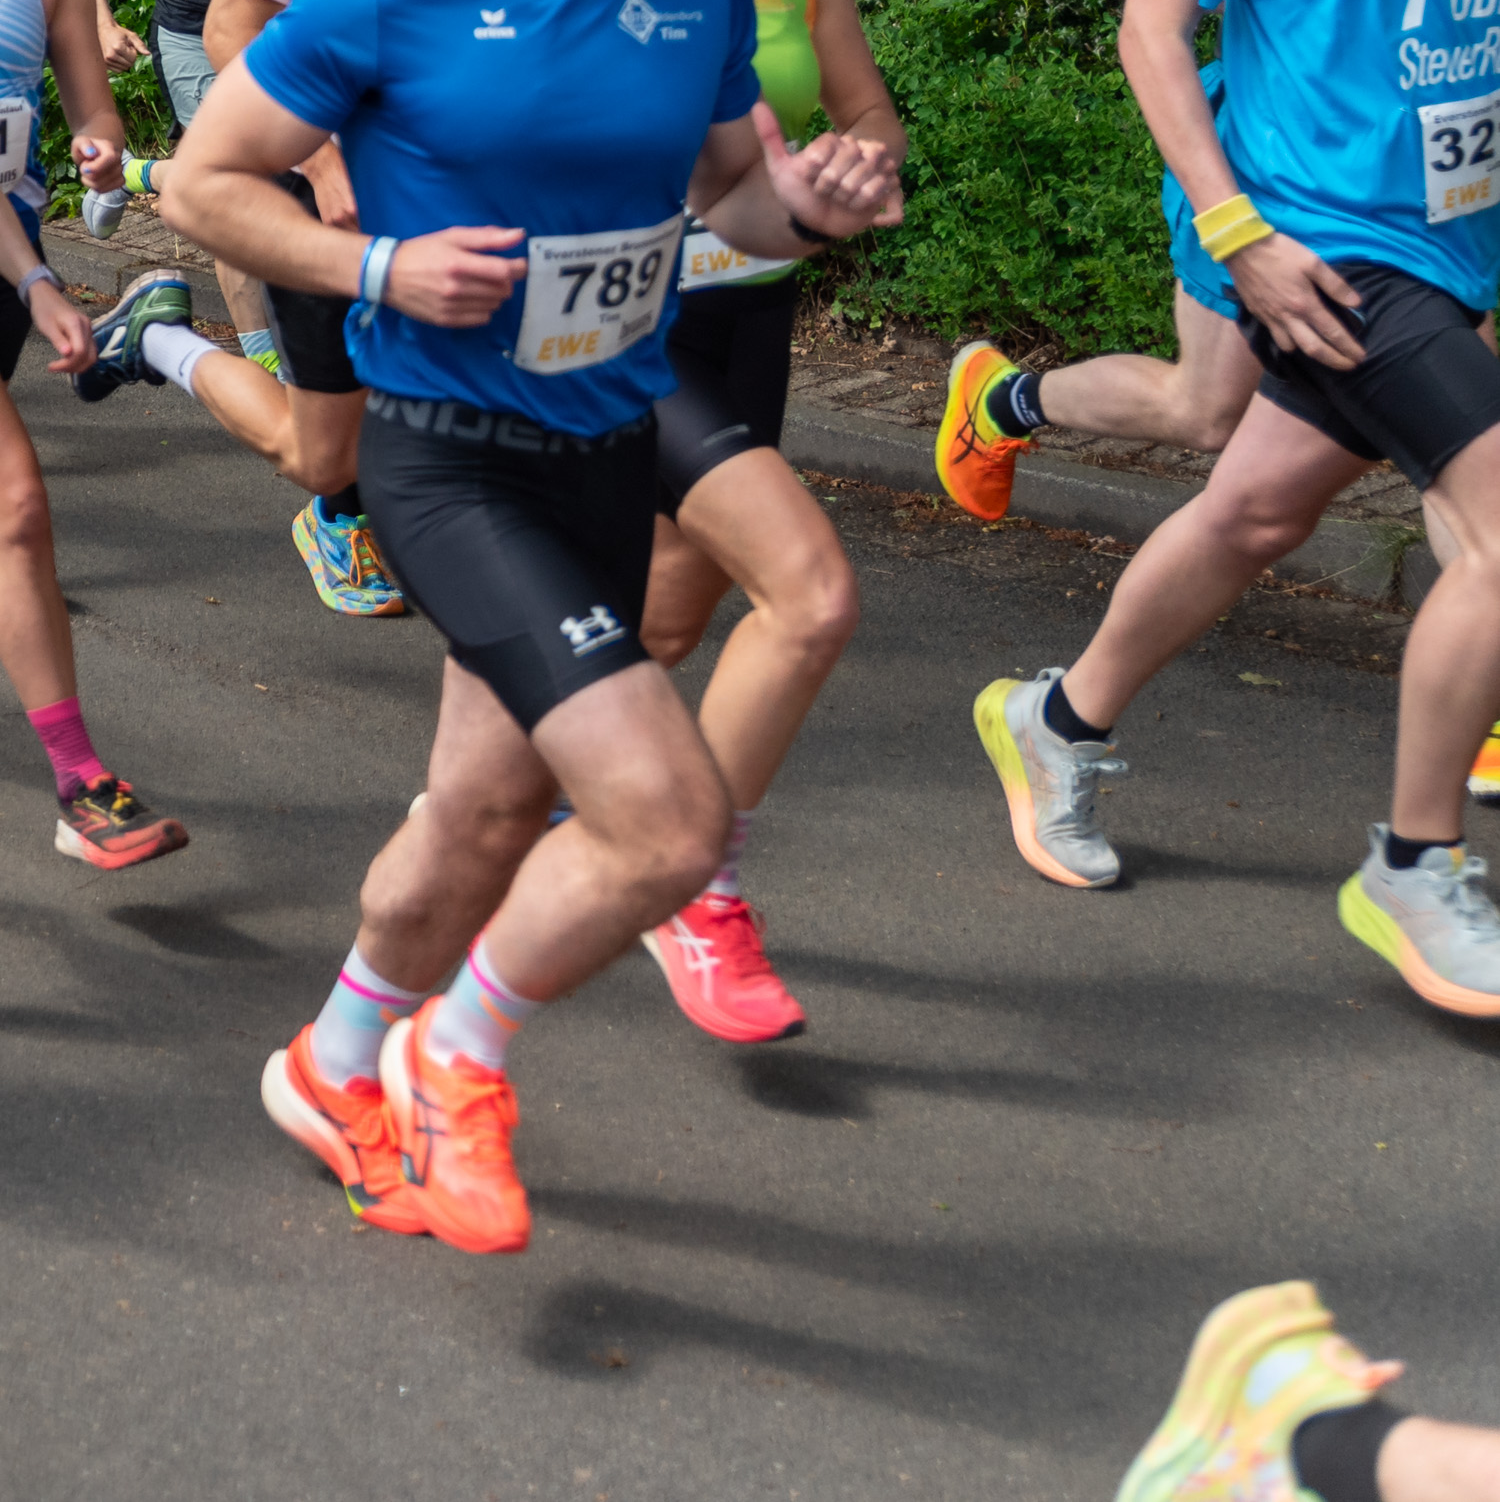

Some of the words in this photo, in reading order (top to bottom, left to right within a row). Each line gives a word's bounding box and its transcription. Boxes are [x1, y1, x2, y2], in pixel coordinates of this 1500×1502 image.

[1430, 118, 1500, 173] 32
[1443, 177, 1491, 209] EWE
[690, 249, 748, 276] EWE
[558, 248, 663, 315] 789
[537, 329, 602, 362] EWE
